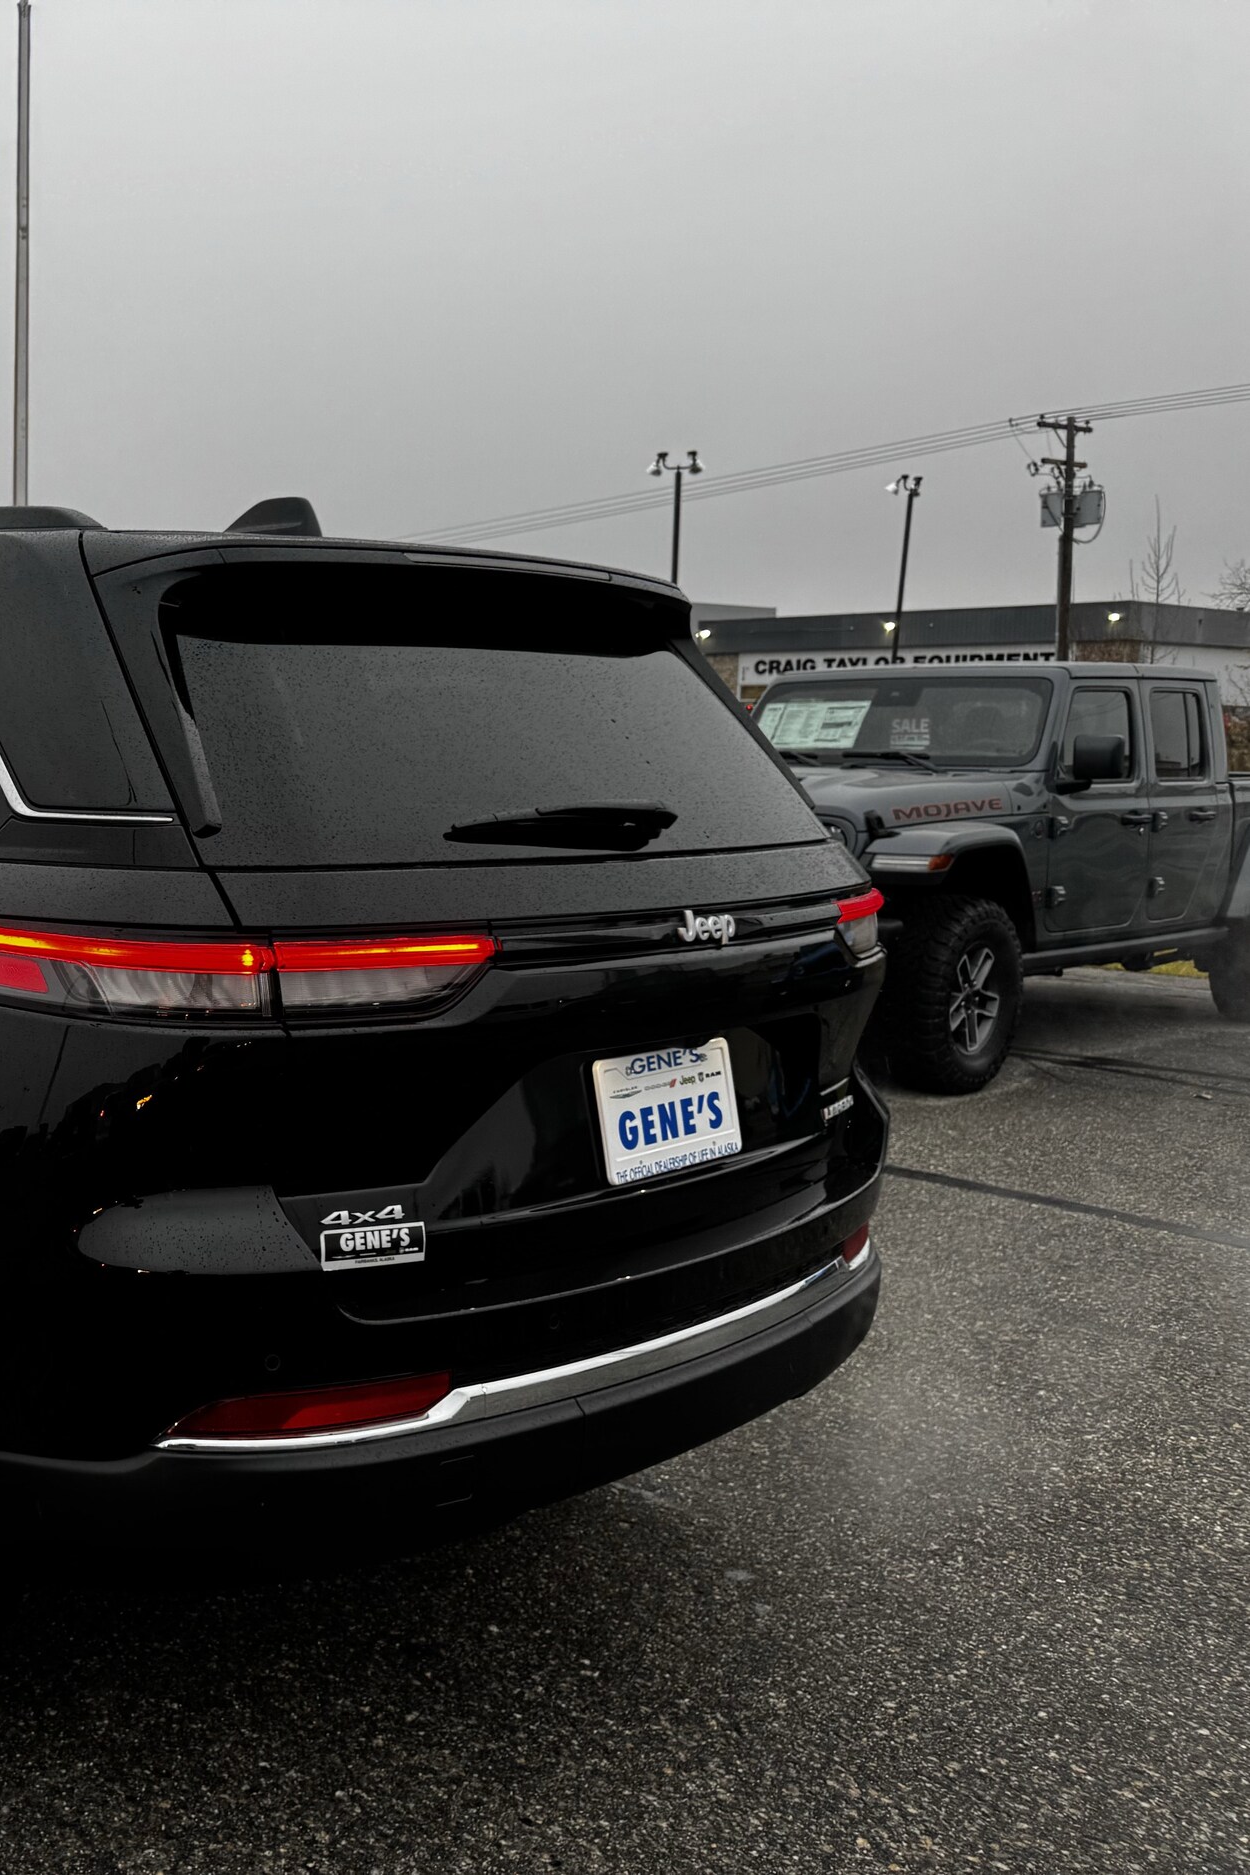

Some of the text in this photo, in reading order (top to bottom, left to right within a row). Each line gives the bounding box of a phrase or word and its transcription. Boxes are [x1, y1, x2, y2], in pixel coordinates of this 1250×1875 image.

[754, 657, 817, 675] CRAIG
[892, 718, 930, 733] SALE
[892, 798, 1003, 820] MOJAVE
[677, 909, 736, 945] Jeep
[630, 1048, 701, 1074] GENE'S
[618, 1091, 723, 1150] GENE'S
[616, 1142, 739, 1183] THE OFFICIAL DEALERSHIP OF LIFE IN ALASKA
[339, 1228, 411, 1252] GENE'S
